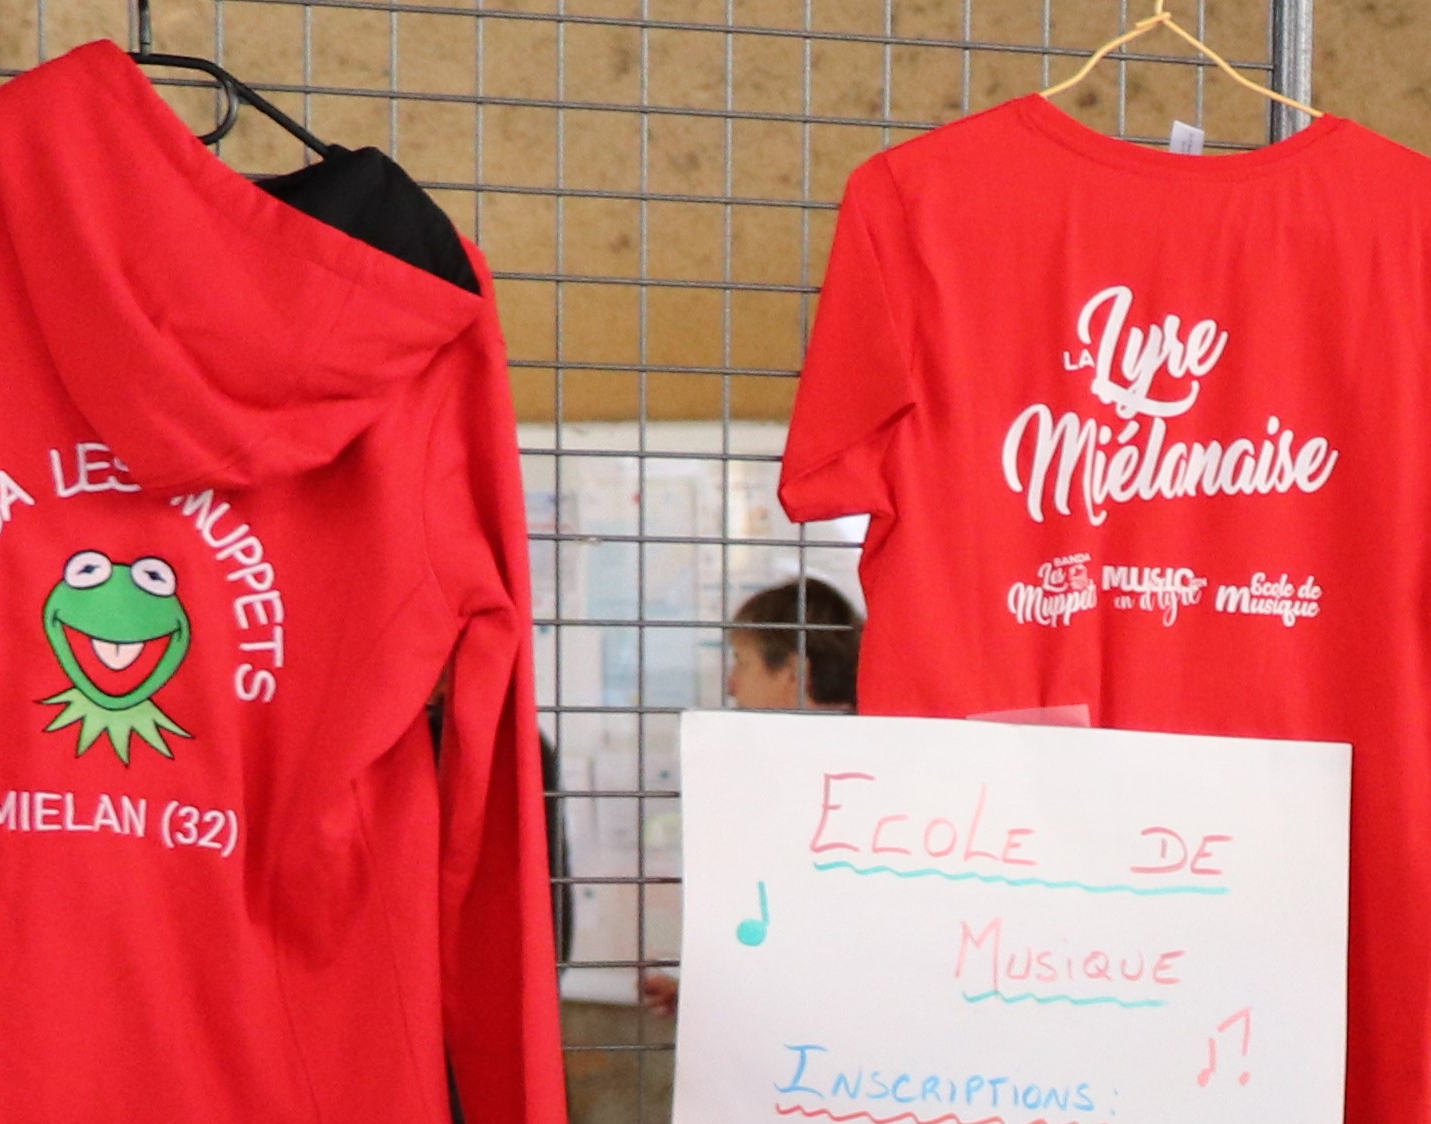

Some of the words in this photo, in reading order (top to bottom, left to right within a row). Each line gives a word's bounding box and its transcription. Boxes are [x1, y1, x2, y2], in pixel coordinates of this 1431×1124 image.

[1063, 349, 1095, 371] LA
[1077, 285, 1229, 419] Lyre
[1002, 403, 1339, 526] Miélanaise
[170, 488, 284, 703] MUPPETS
[1297, 575, 1323, 600] de
[161, 800, 238, 857] (32)
[1130, 826, 1234, 876] DE
